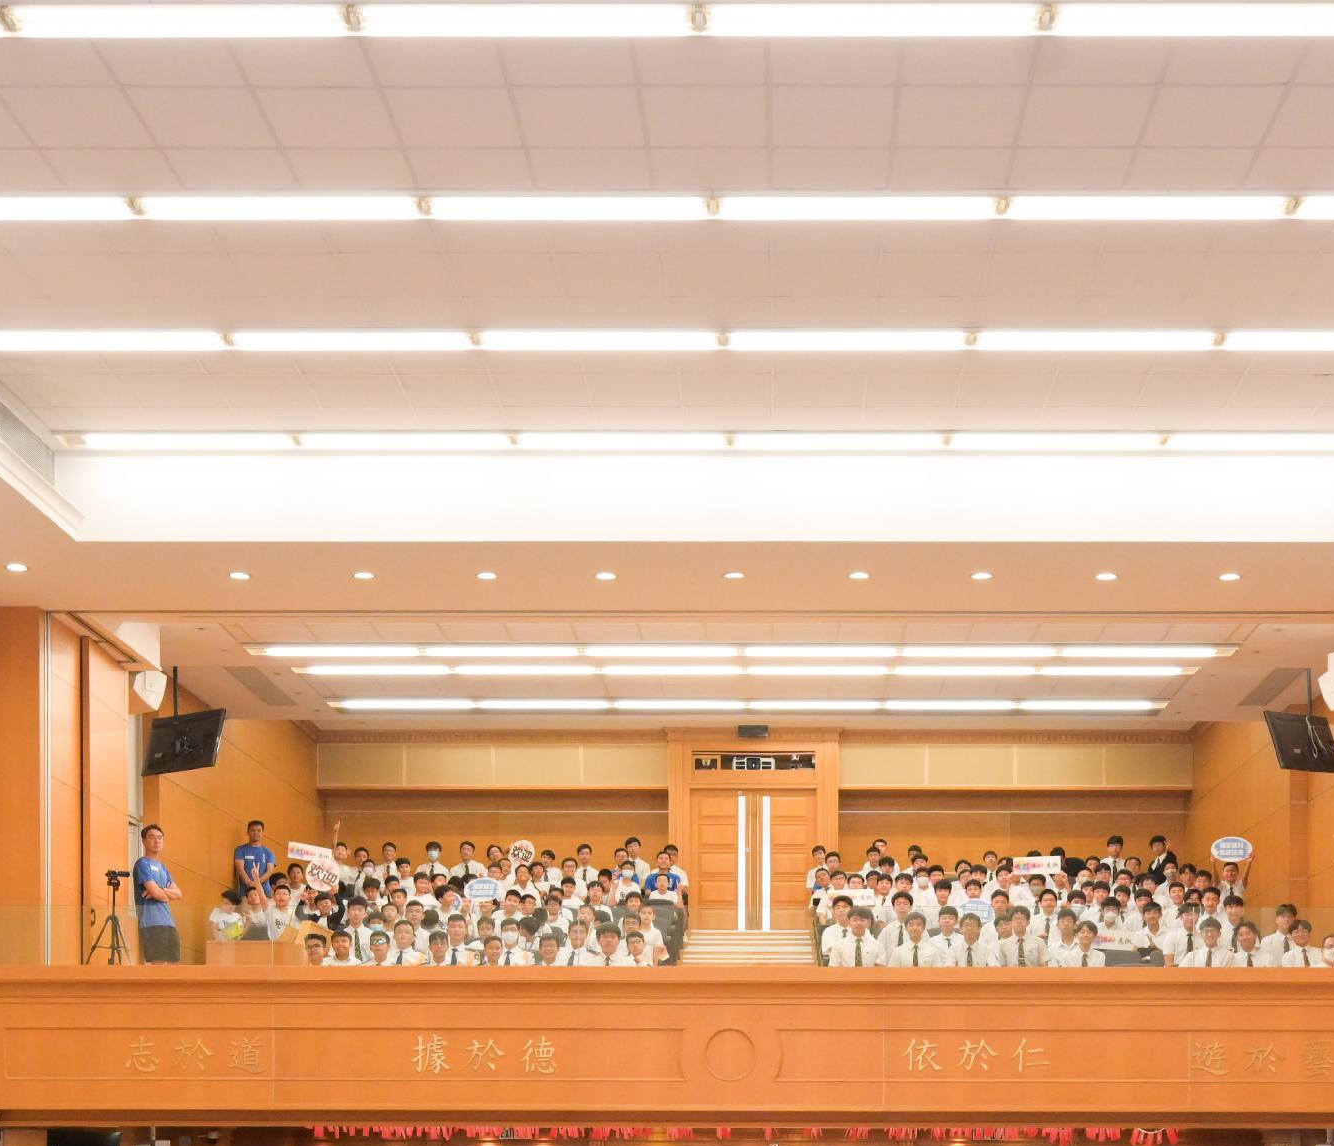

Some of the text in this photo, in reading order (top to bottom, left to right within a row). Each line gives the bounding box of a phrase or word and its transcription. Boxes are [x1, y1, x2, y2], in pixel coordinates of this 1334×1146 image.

[308, 863, 338, 887] 欢迎
[124, 1036, 267, 1075] 志於道
[412, 1035, 559, 1075] 據於德
[902, 1037, 1051, 1074] 依於仁
